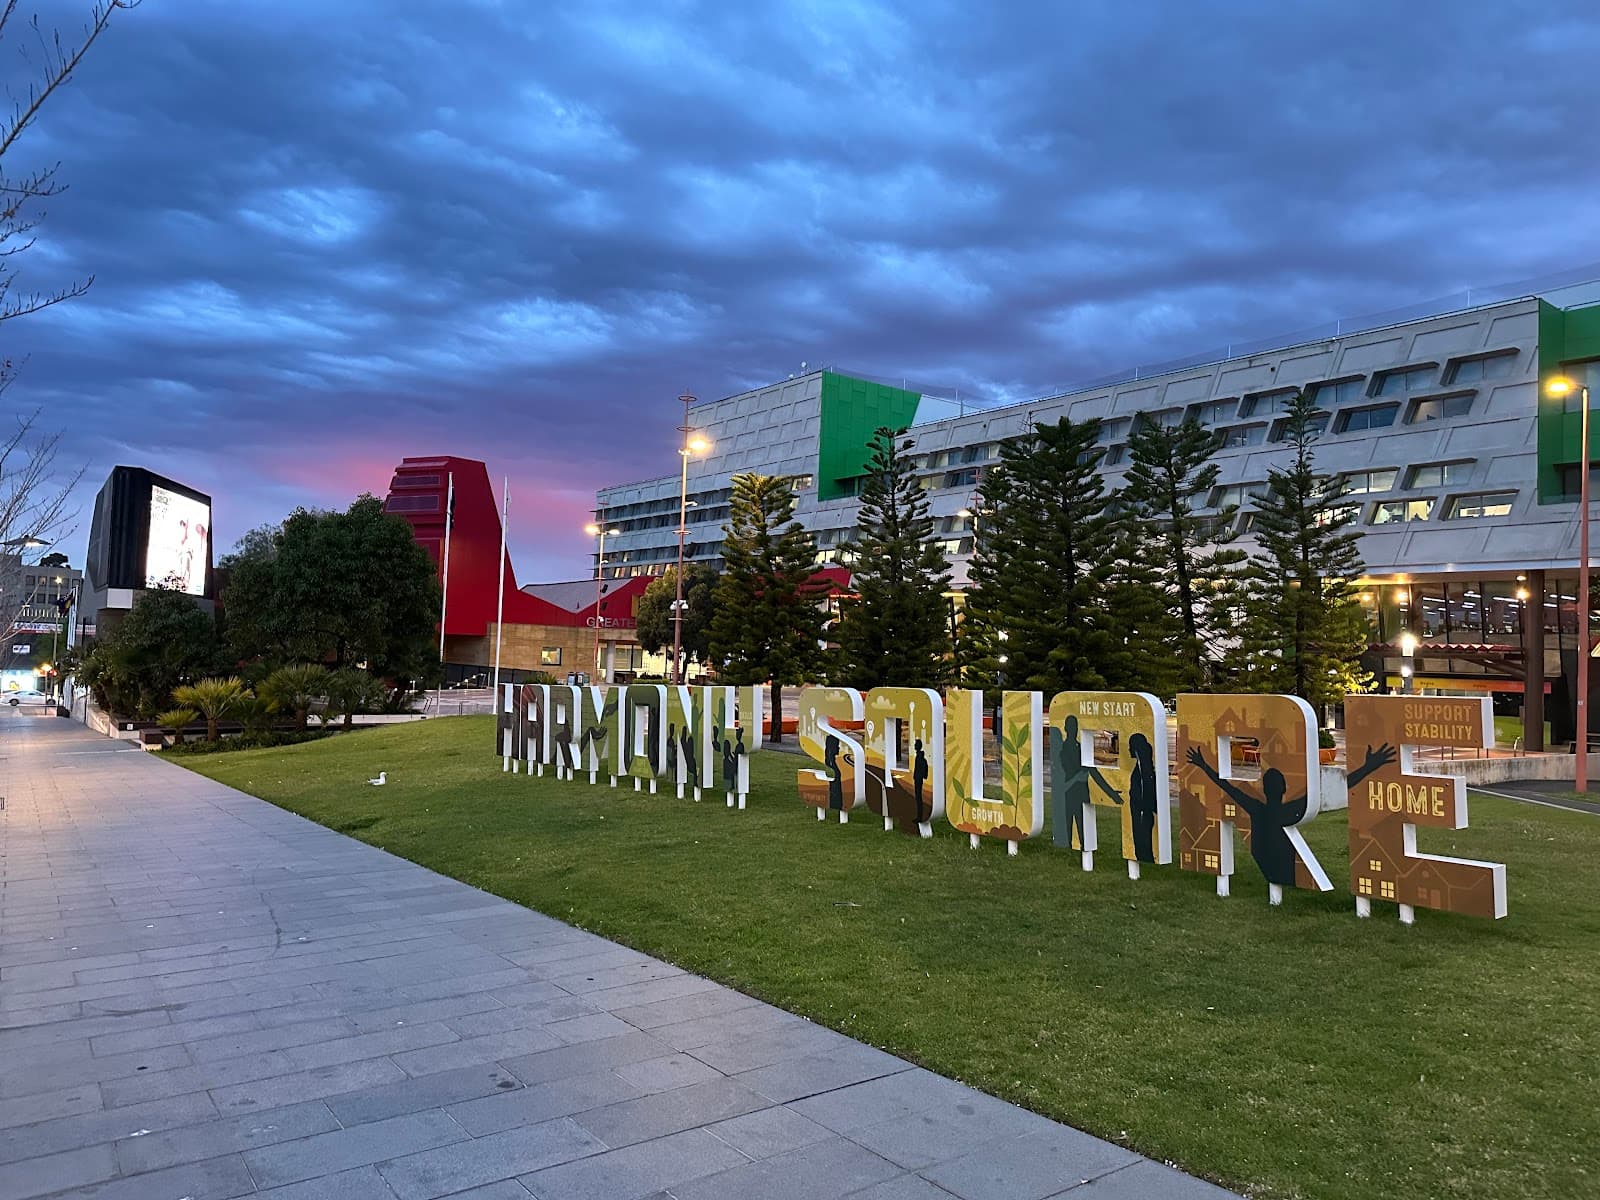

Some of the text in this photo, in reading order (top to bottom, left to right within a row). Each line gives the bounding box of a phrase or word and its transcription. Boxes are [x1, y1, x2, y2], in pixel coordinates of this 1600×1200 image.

[1080, 701, 1135, 716] NEW START
[1404, 703, 1472, 722] SUPPORT
[1405, 723, 1472, 740] STABILITY
[496, 684, 1507, 920] HARMONY SQUARE
[1368, 780, 1445, 817] HOME
[971, 807, 1003, 825] GROWTH
